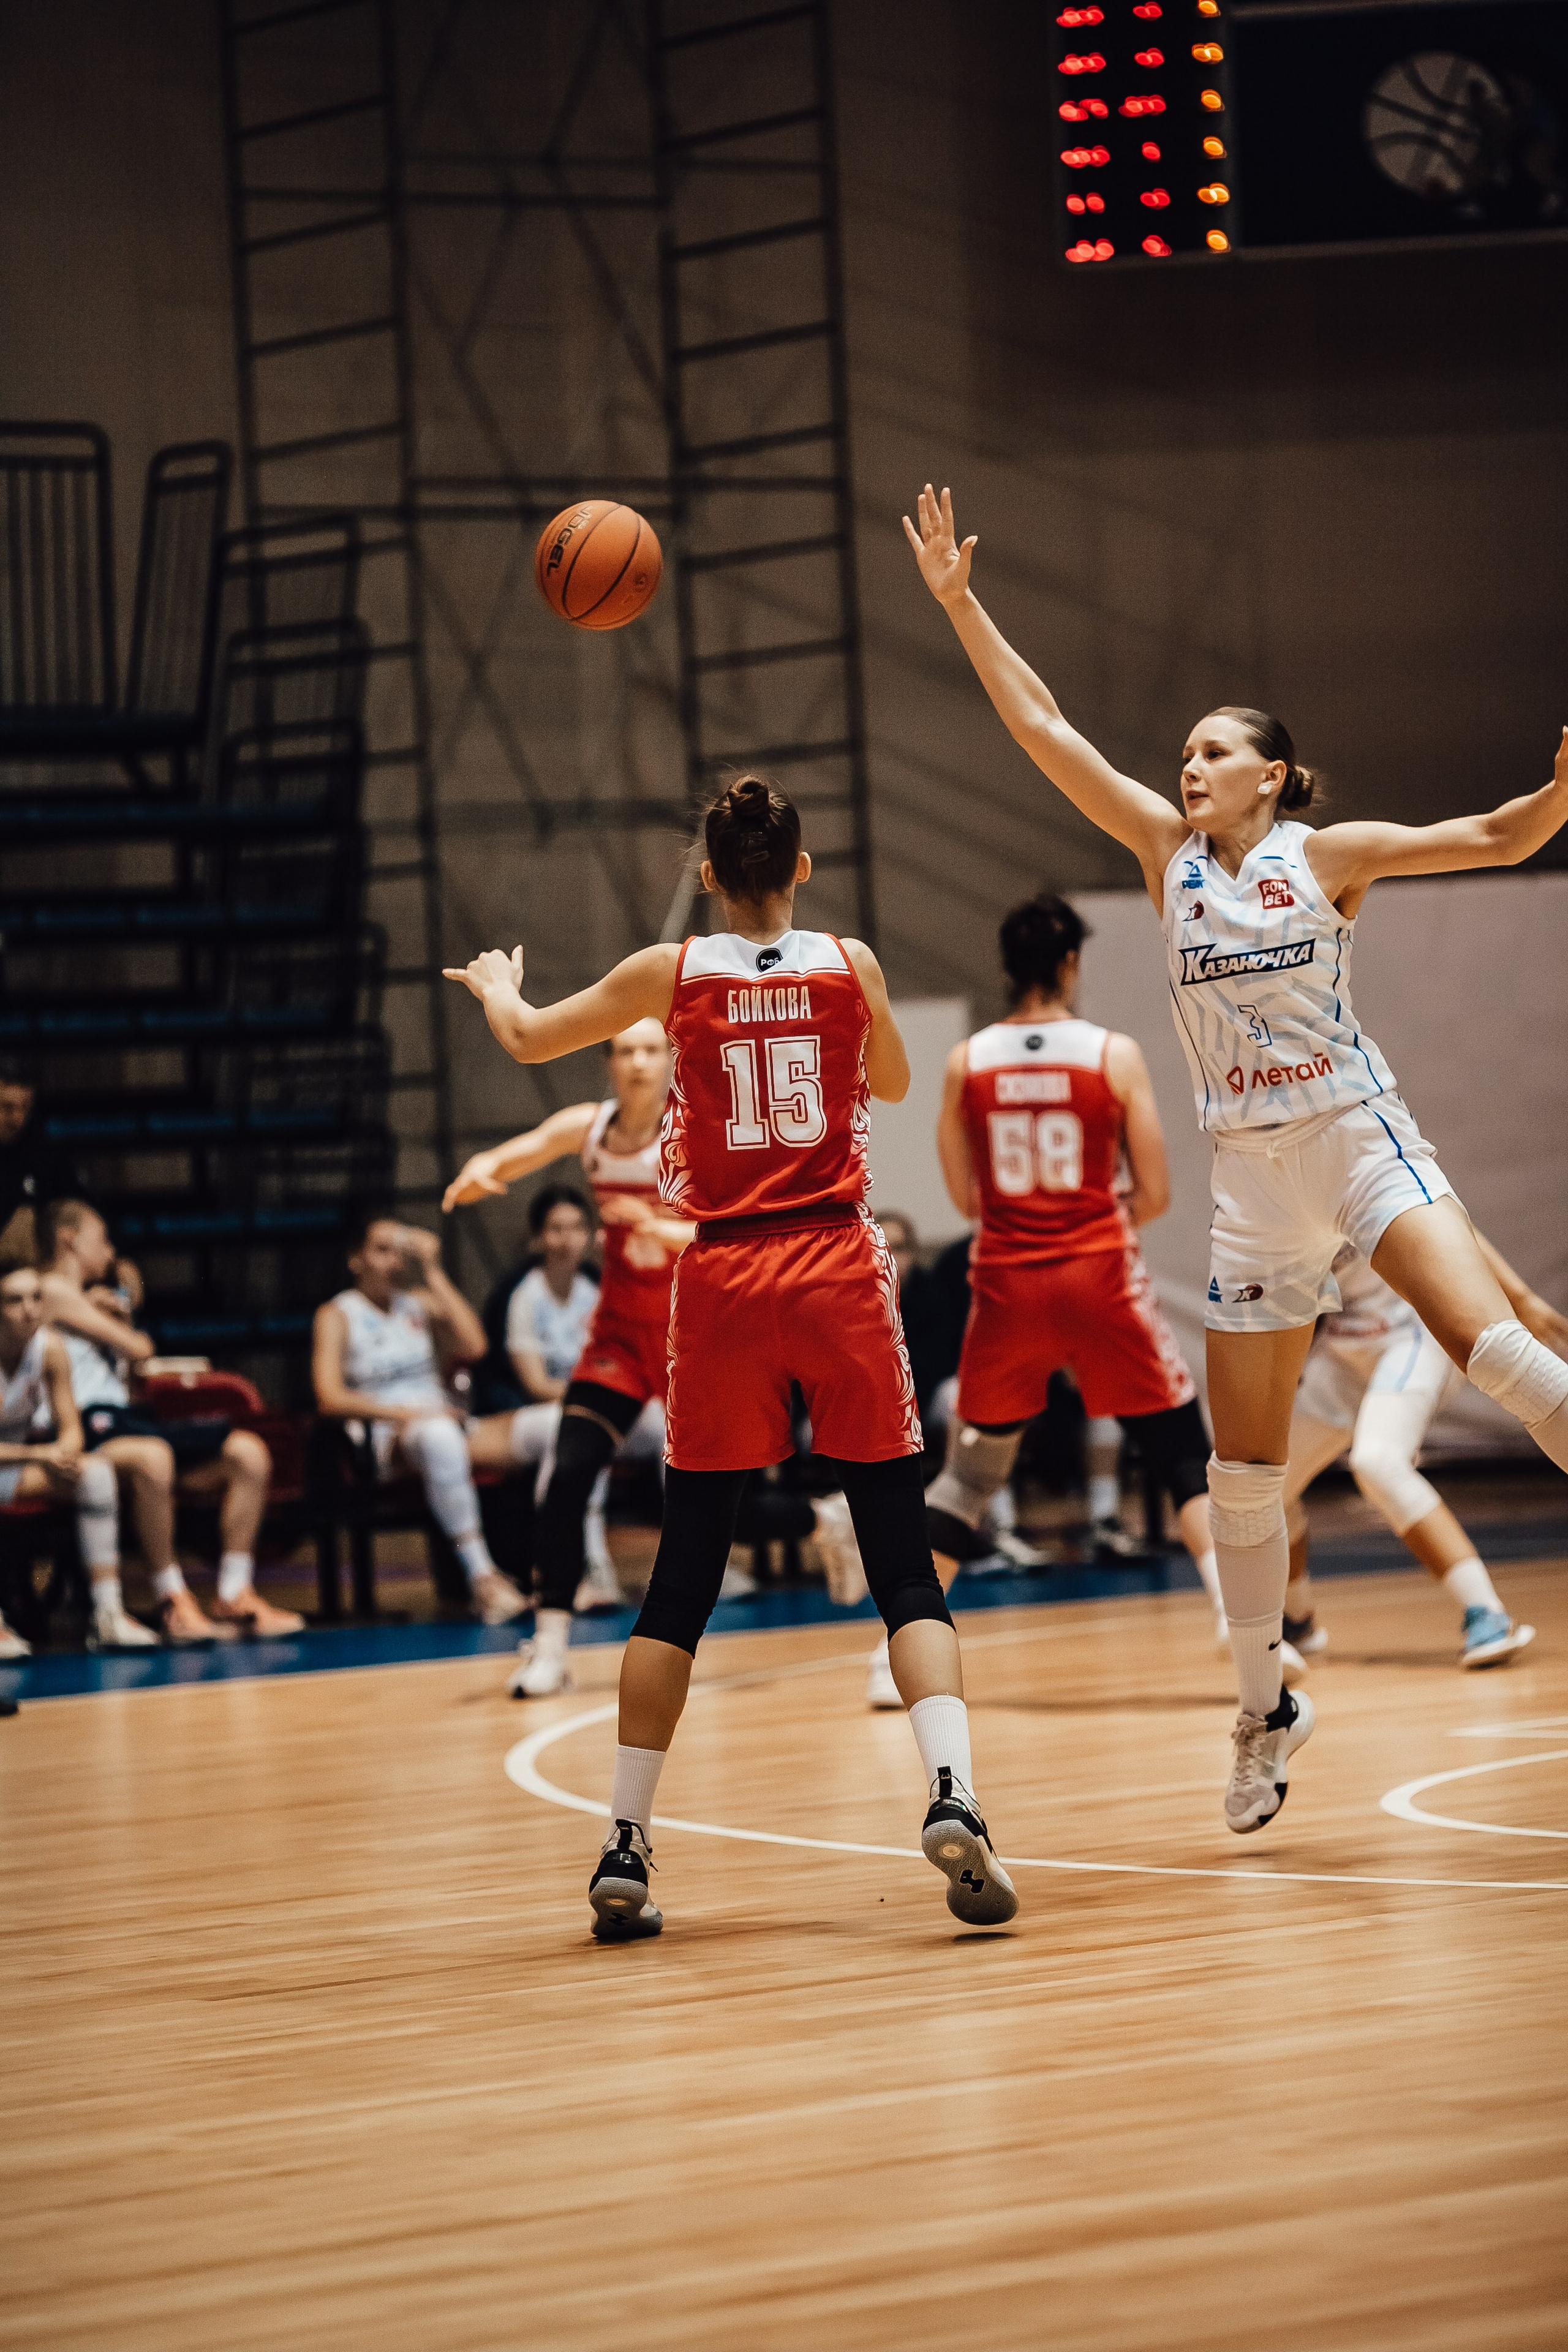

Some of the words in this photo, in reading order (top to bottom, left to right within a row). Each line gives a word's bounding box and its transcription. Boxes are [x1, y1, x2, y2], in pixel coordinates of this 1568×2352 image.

[1262, 881, 1287, 894] FON
[1264, 891, 1291, 907] BET
[1184, 945, 1311, 982] КАЗАНОЧКА
[728, 986, 812, 1023] БОЙКОВА
[1237, 1005, 1272, 1048] 3
[720, 1036, 827, 1150] 15
[987, 1109, 1084, 1196] 58
